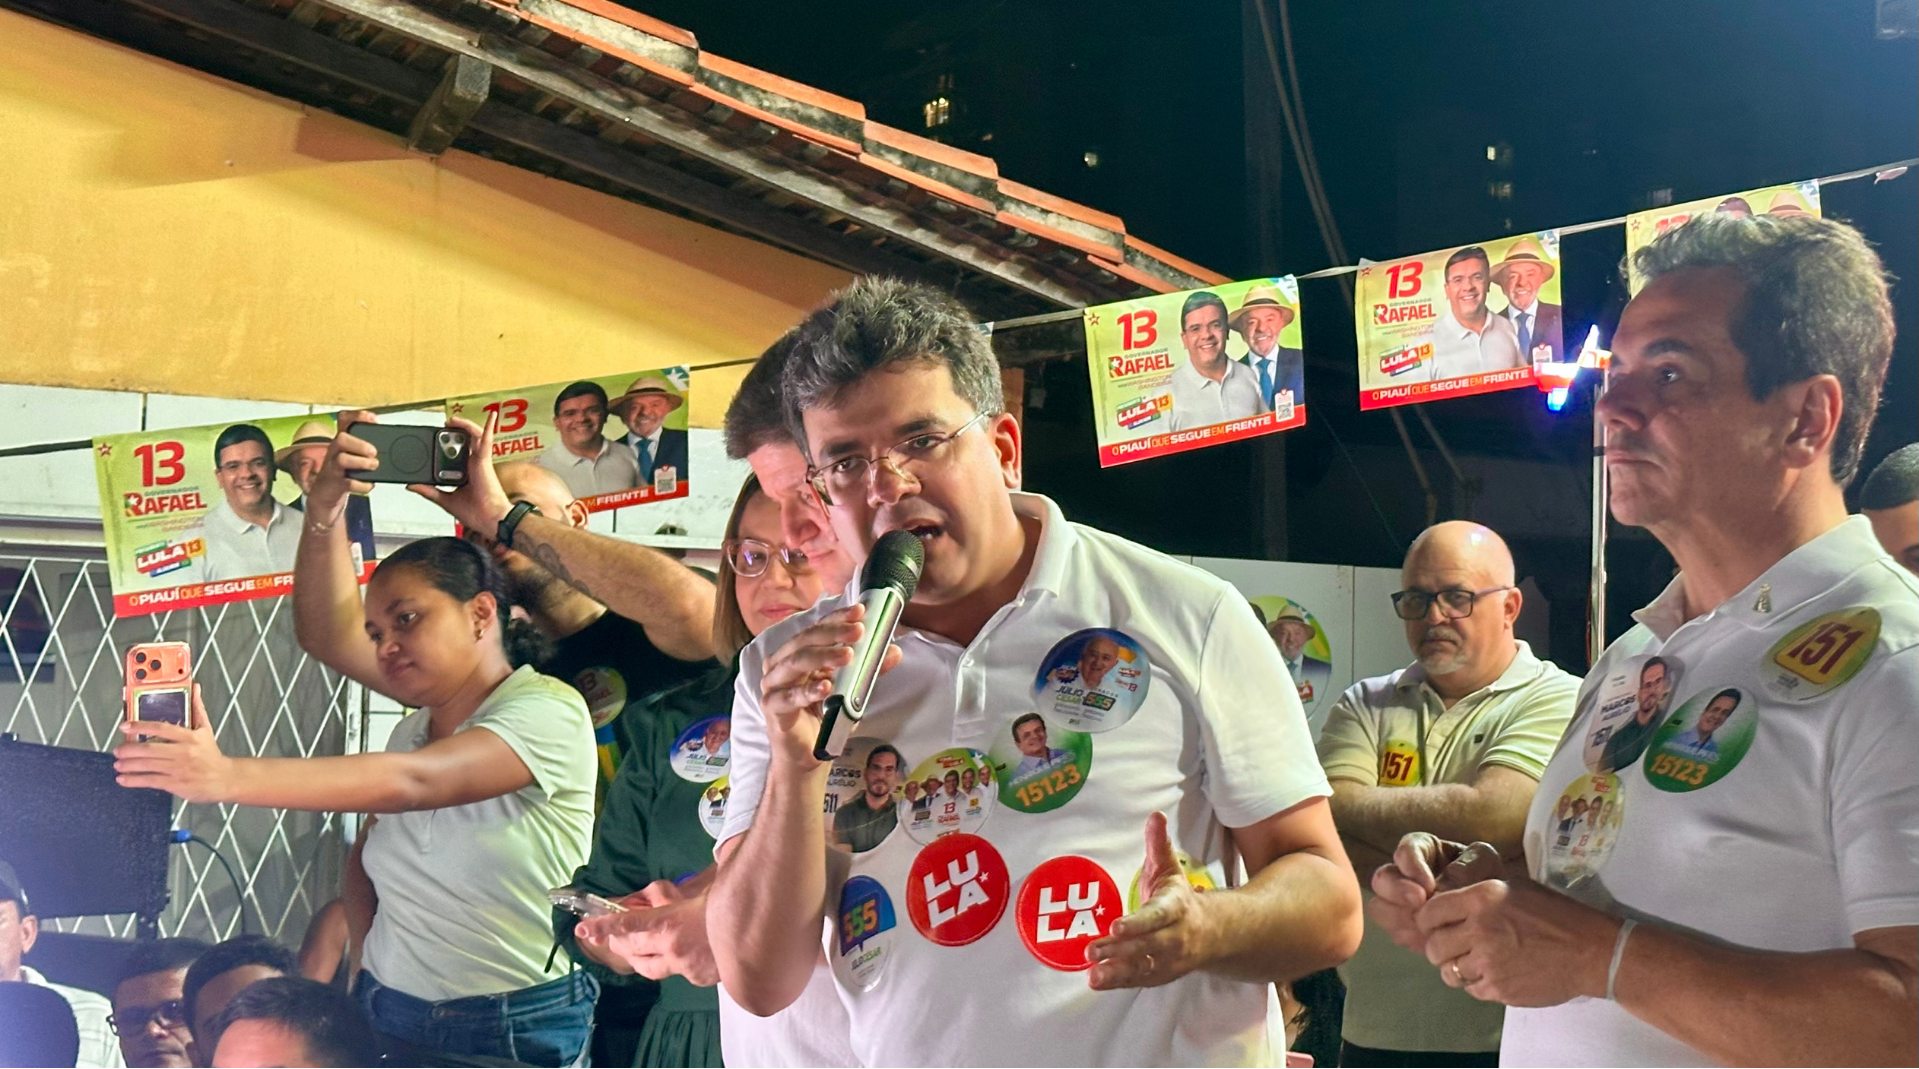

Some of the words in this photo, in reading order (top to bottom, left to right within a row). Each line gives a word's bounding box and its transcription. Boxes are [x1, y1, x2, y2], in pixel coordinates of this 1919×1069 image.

[1385, 261, 1424, 299] 13
[1373, 303, 1437, 325] RAFAEL
[1117, 309, 1157, 351] 13
[1108, 353, 1175, 379] RAFAEL
[1380, 348, 1418, 370] LULA
[1420, 344, 1430, 357] 13
[1372, 391, 1380, 401] O
[1380, 385, 1411, 400] PIAUÍ
[1411, 383, 1430, 395] QUE
[1430, 379, 1470, 392] SEGUE
[1470, 377, 1483, 387] EM
[1483, 369, 1529, 384] FRENTE
[482, 398, 529, 434] 13
[1117, 399, 1157, 423] LULA
[1158, 395, 1169, 408] 13
[492, 436, 545, 456] AFAEL
[1111, 446, 1119, 456] O
[1119, 437, 1151, 455] PIAUÍ
[1151, 435, 1170, 448] QUE
[1170, 429, 1211, 445] SEGUE
[1211, 426, 1225, 437] EM
[1225, 415, 1272, 434] FRENTE
[134, 441, 186, 487] 13
[123, 492, 208, 517] RAFAEL
[596, 488, 649, 506] FRENTE
[137, 544, 186, 569] LULA
[188, 539, 202, 554] 13
[139, 587, 180, 605] PIAUÍ
[180, 588, 203, 600] QUE
[203, 581, 255, 597] SEGUE
[1787, 621, 1865, 675] 151
[829, 766, 861, 779] ARCOS
[1381, 751, 1414, 781] 151
[1650, 753, 1709, 786] 15123
[1016, 764, 1082, 807] 15123
[824, 792, 839, 813] 511
[943, 801, 956, 814] 13
[843, 898, 878, 944] 555
